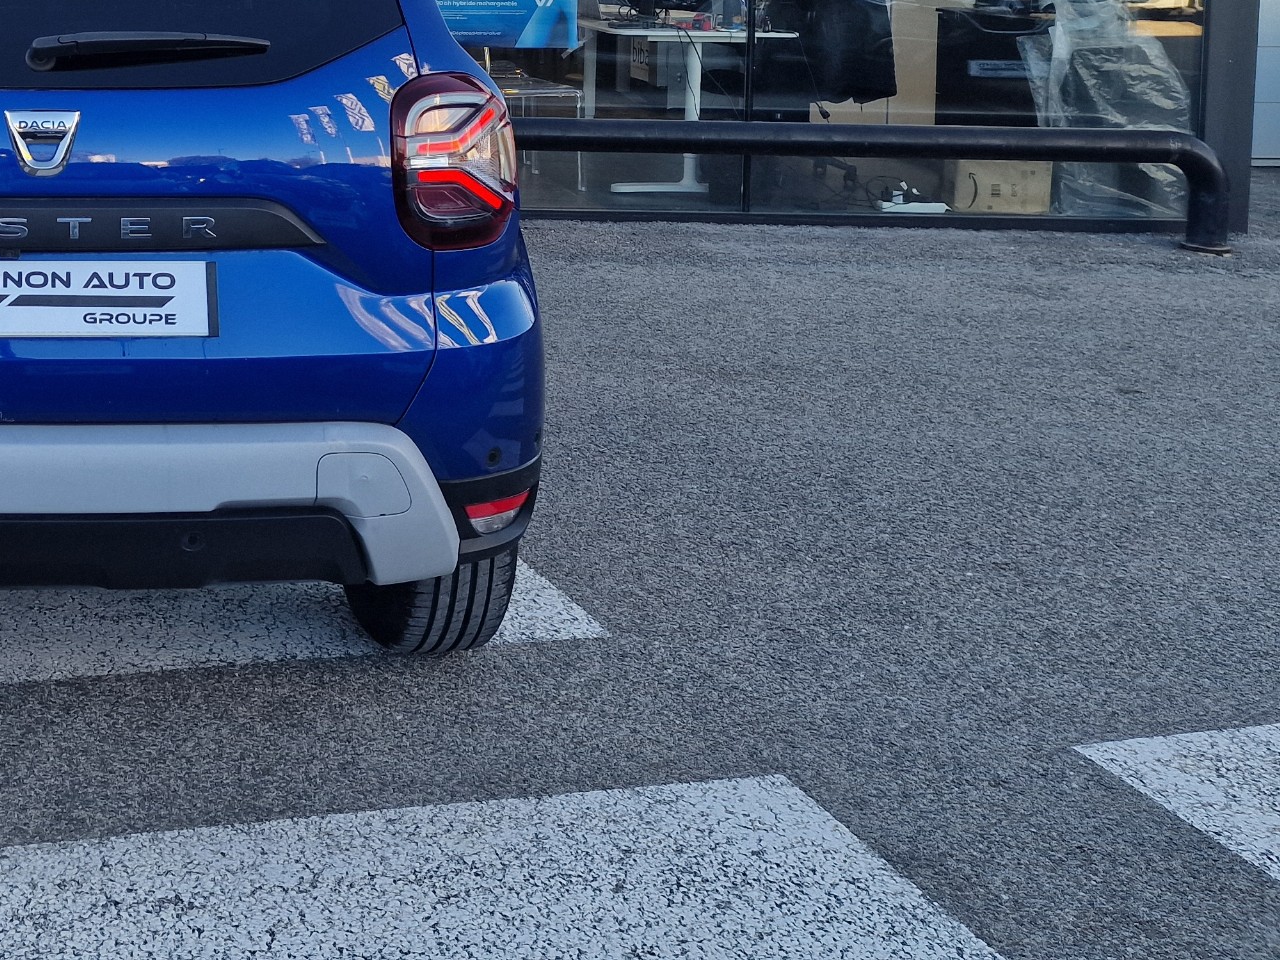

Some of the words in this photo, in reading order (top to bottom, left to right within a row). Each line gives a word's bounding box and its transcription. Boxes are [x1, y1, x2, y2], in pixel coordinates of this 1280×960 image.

[19, 120, 68, 130] DACIA
[82, 271, 176, 290] AUTO
[83, 312, 177, 326] GROUPE
